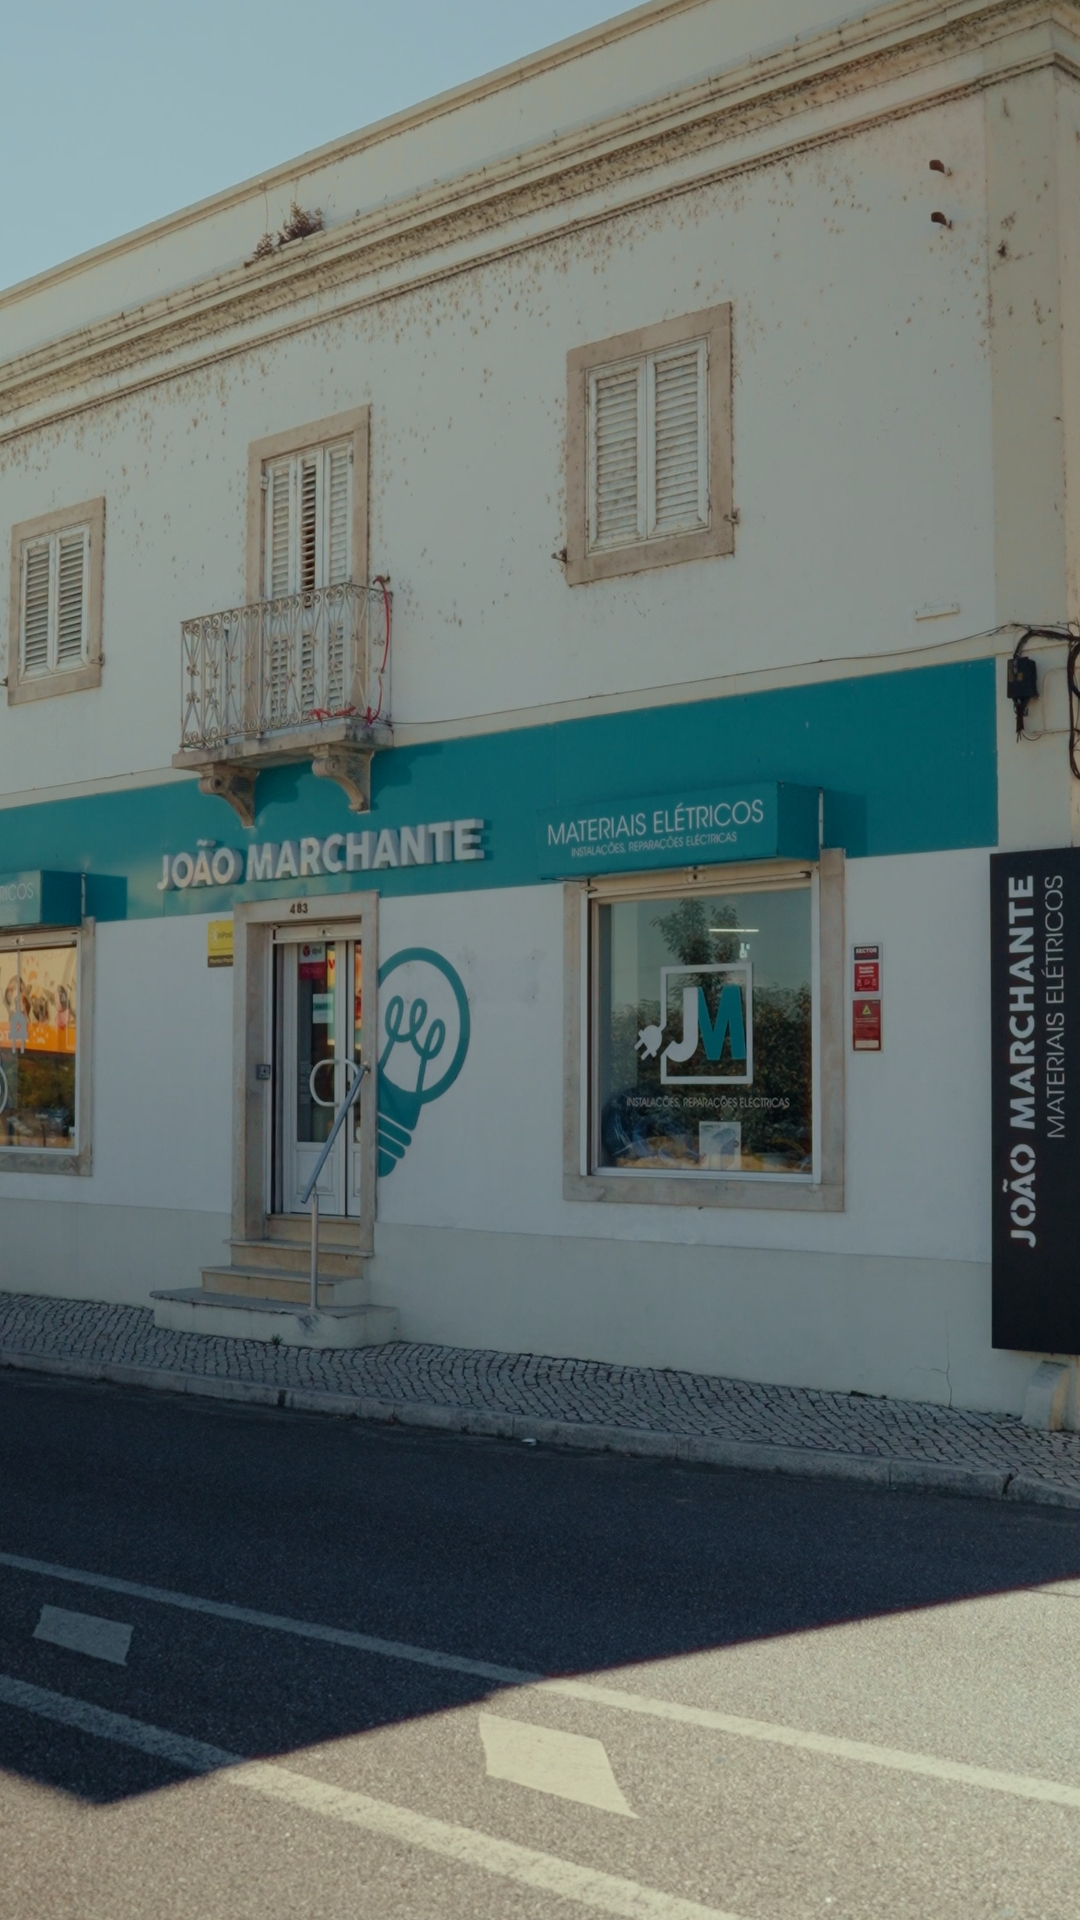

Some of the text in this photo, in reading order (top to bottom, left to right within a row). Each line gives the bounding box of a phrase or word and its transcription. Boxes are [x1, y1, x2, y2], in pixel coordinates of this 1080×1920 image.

[547, 799, 764, 845] MATERIAIS ELÉTRICOS
[571, 831, 737, 858] INSTALAÇÕES, REPARAÇÕES ELÉCTRICAS
[156, 819, 485, 891] JOÃO MARCHANTE
[289, 903, 309, 914] 483
[666, 984, 746, 1062] JM
[1041, 875, 1065, 1138] MATERIAIS ELÉTRICOS
[1003, 875, 1037, 1248] JOÃO MARCHANTE
[683, 1095, 738, 1109] REPARAÇÕES
[740, 1095, 790, 1108] ELÉCTRICAS
